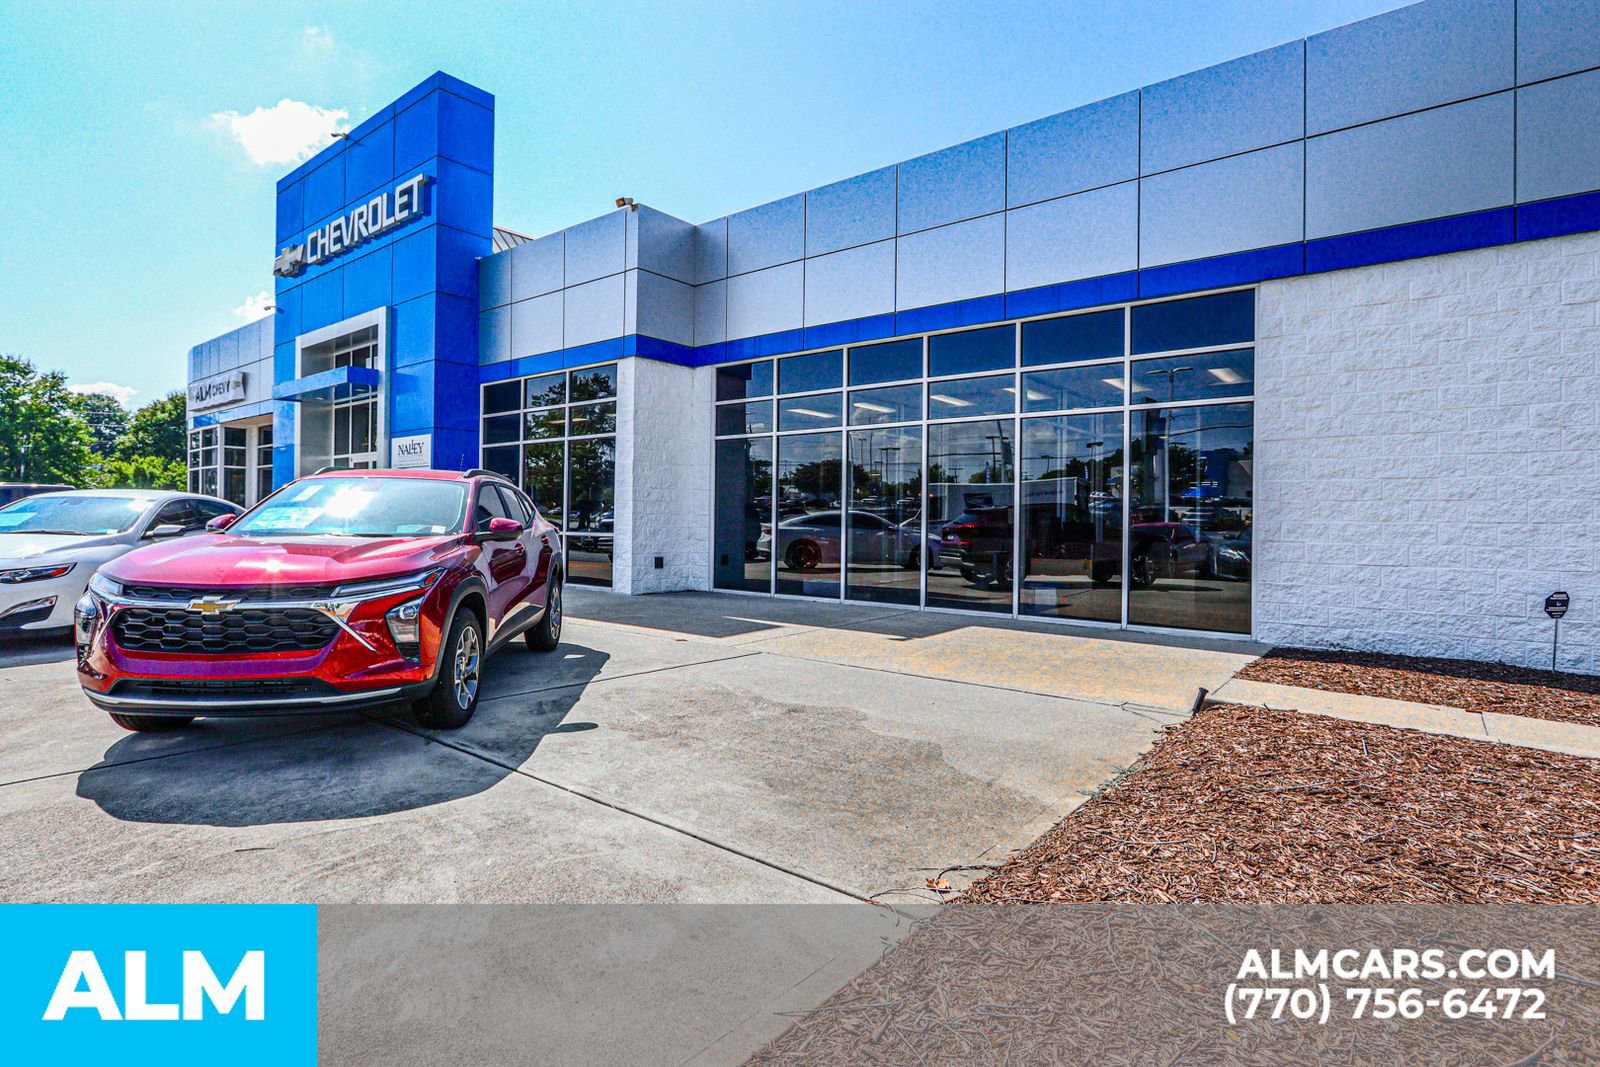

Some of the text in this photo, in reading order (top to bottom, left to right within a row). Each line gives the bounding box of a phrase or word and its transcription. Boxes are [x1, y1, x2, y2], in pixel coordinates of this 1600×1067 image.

[307, 173, 425, 264] CHEVROLET
[195, 380, 230, 402] ALM CHEVY
[398, 440, 424, 456] NALLEY
